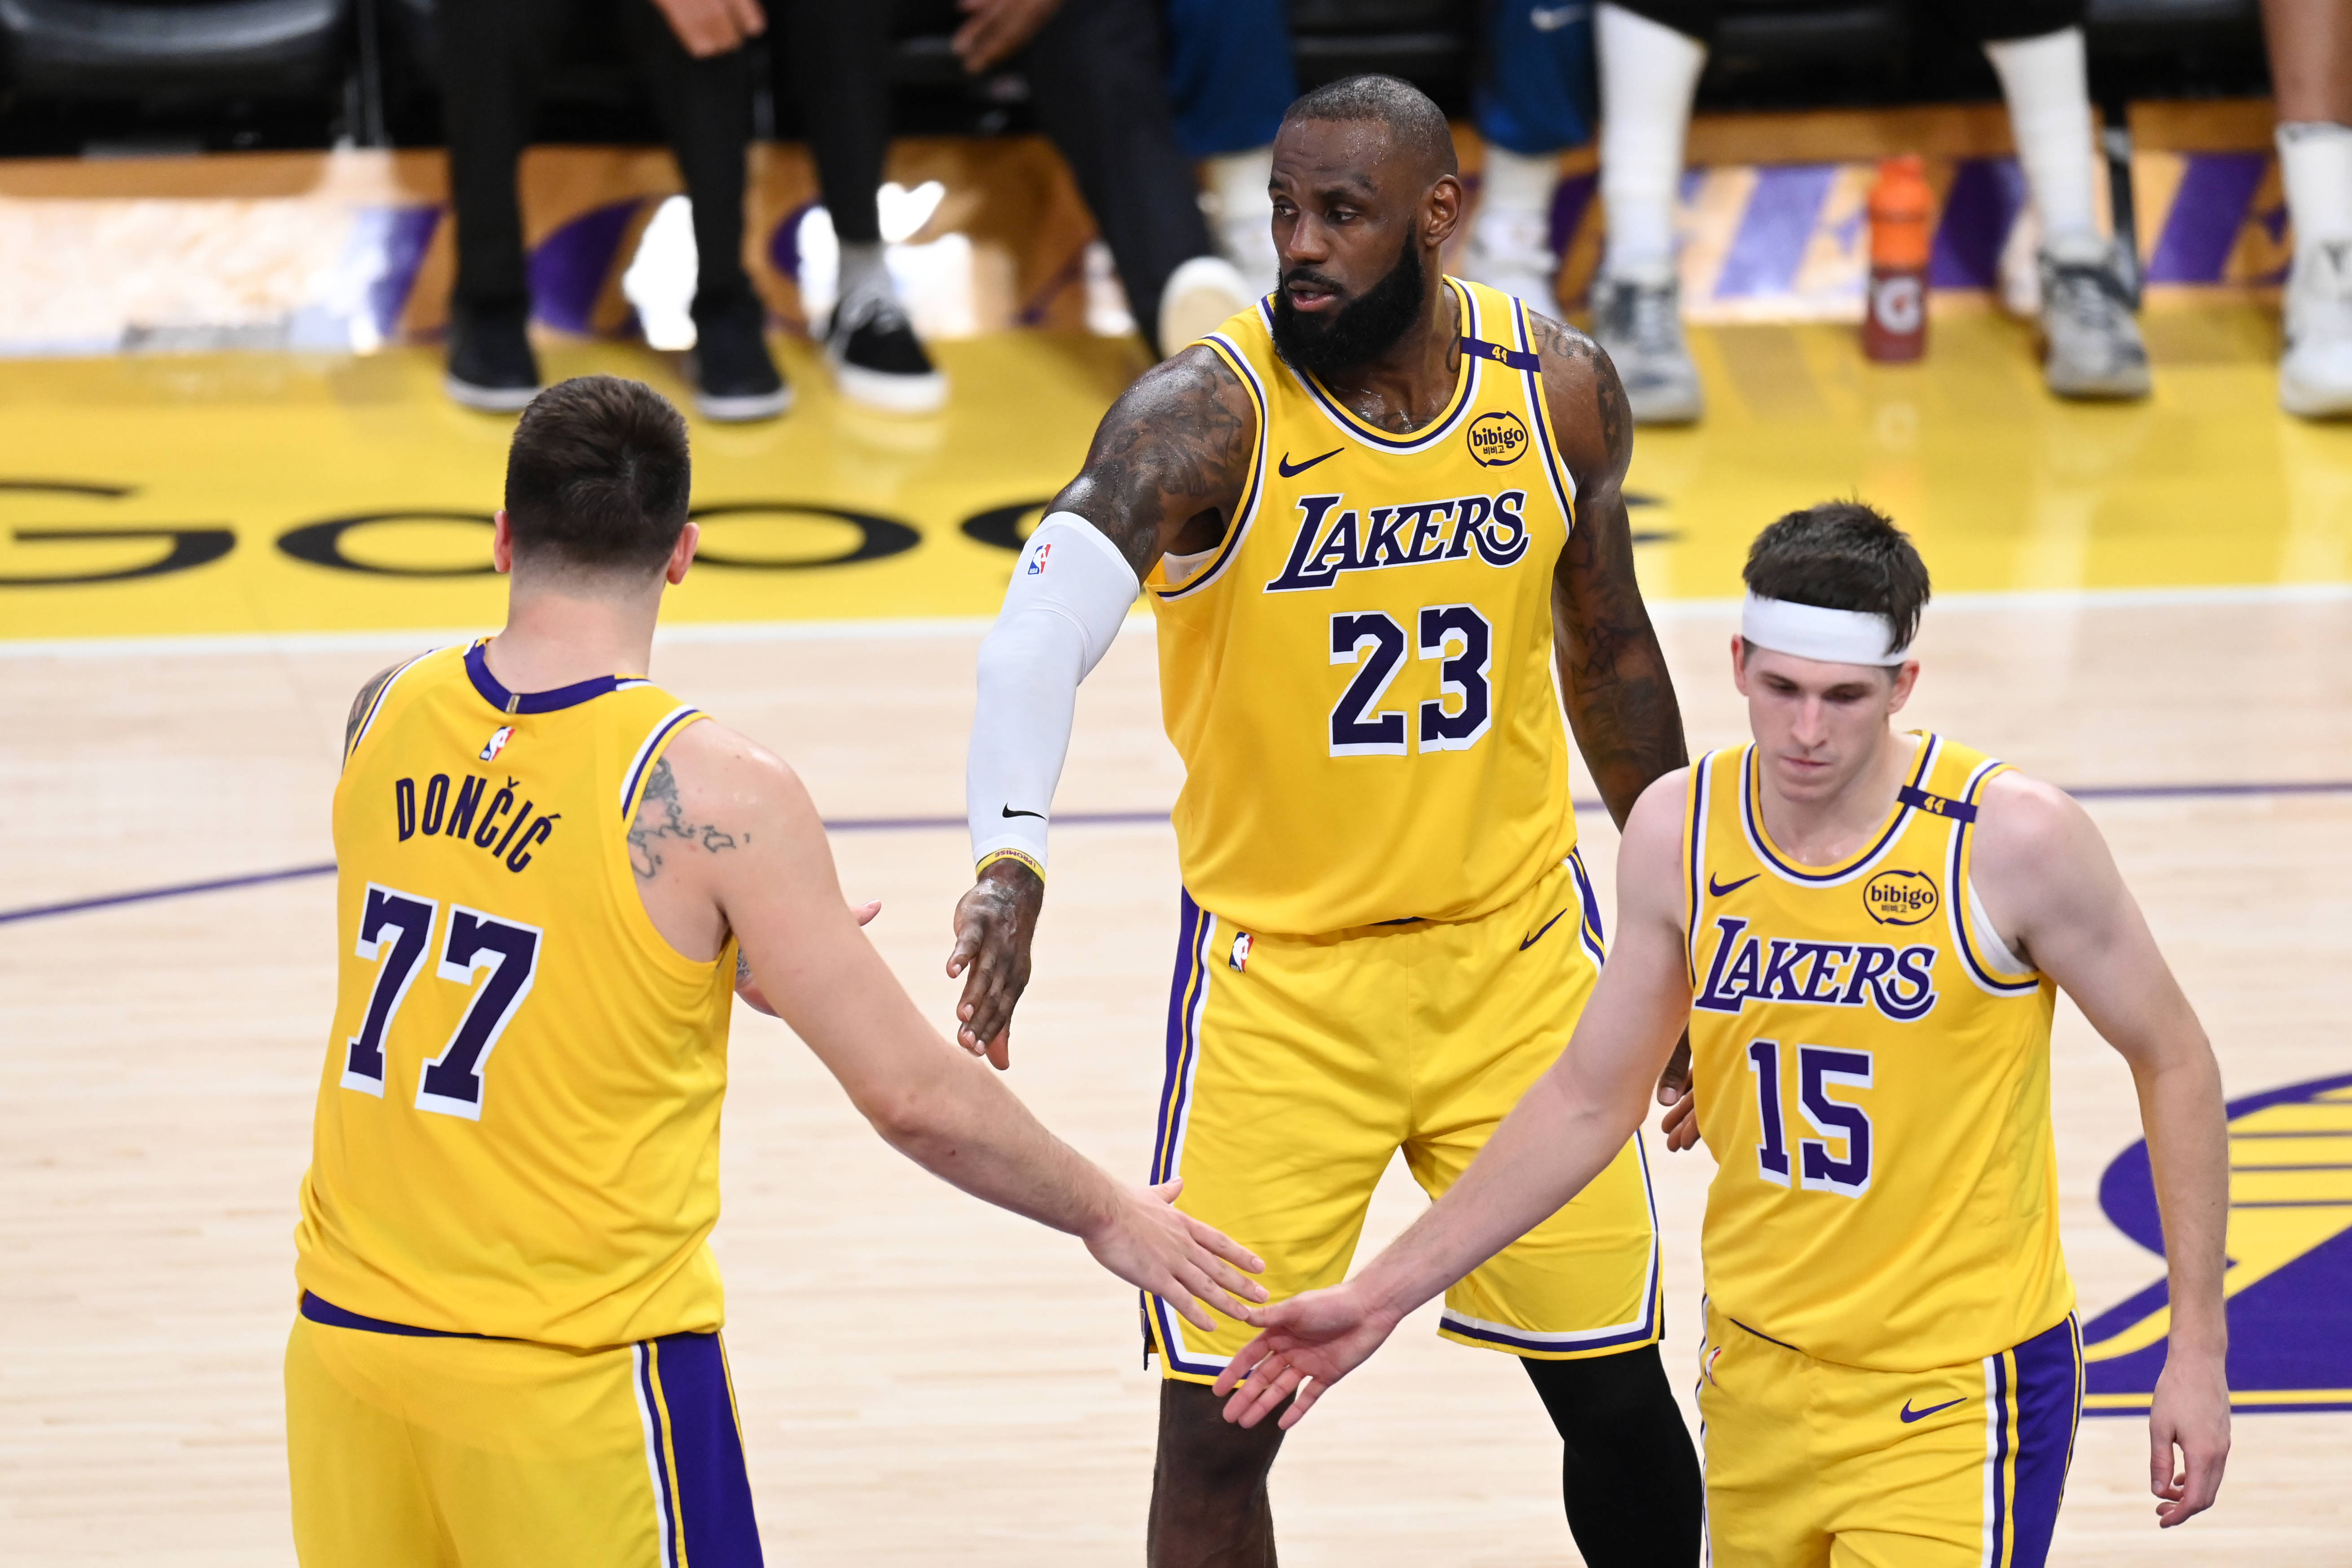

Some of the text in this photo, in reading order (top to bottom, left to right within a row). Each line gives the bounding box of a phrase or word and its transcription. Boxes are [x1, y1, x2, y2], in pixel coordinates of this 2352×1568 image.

[1875, 277, 1922, 335] G
[1492, 346, 1507, 363] 44
[1472, 426, 1524, 449] bibigo
[1483, 445, 1505, 455] 비비고
[1262, 489, 1531, 594] LAKERS
[1329, 603, 1492, 757] 23
[396, 773, 561, 873] DONČIĆ
[1924, 796, 1946, 814] 44
[995, 850, 1033, 865] PROMISE
[1871, 885, 1933, 910] bibigo
[1694, 914, 1940, 1023] LAKERS
[340, 881, 543, 1122] 77
[1746, 1037, 1874, 1199] 15
